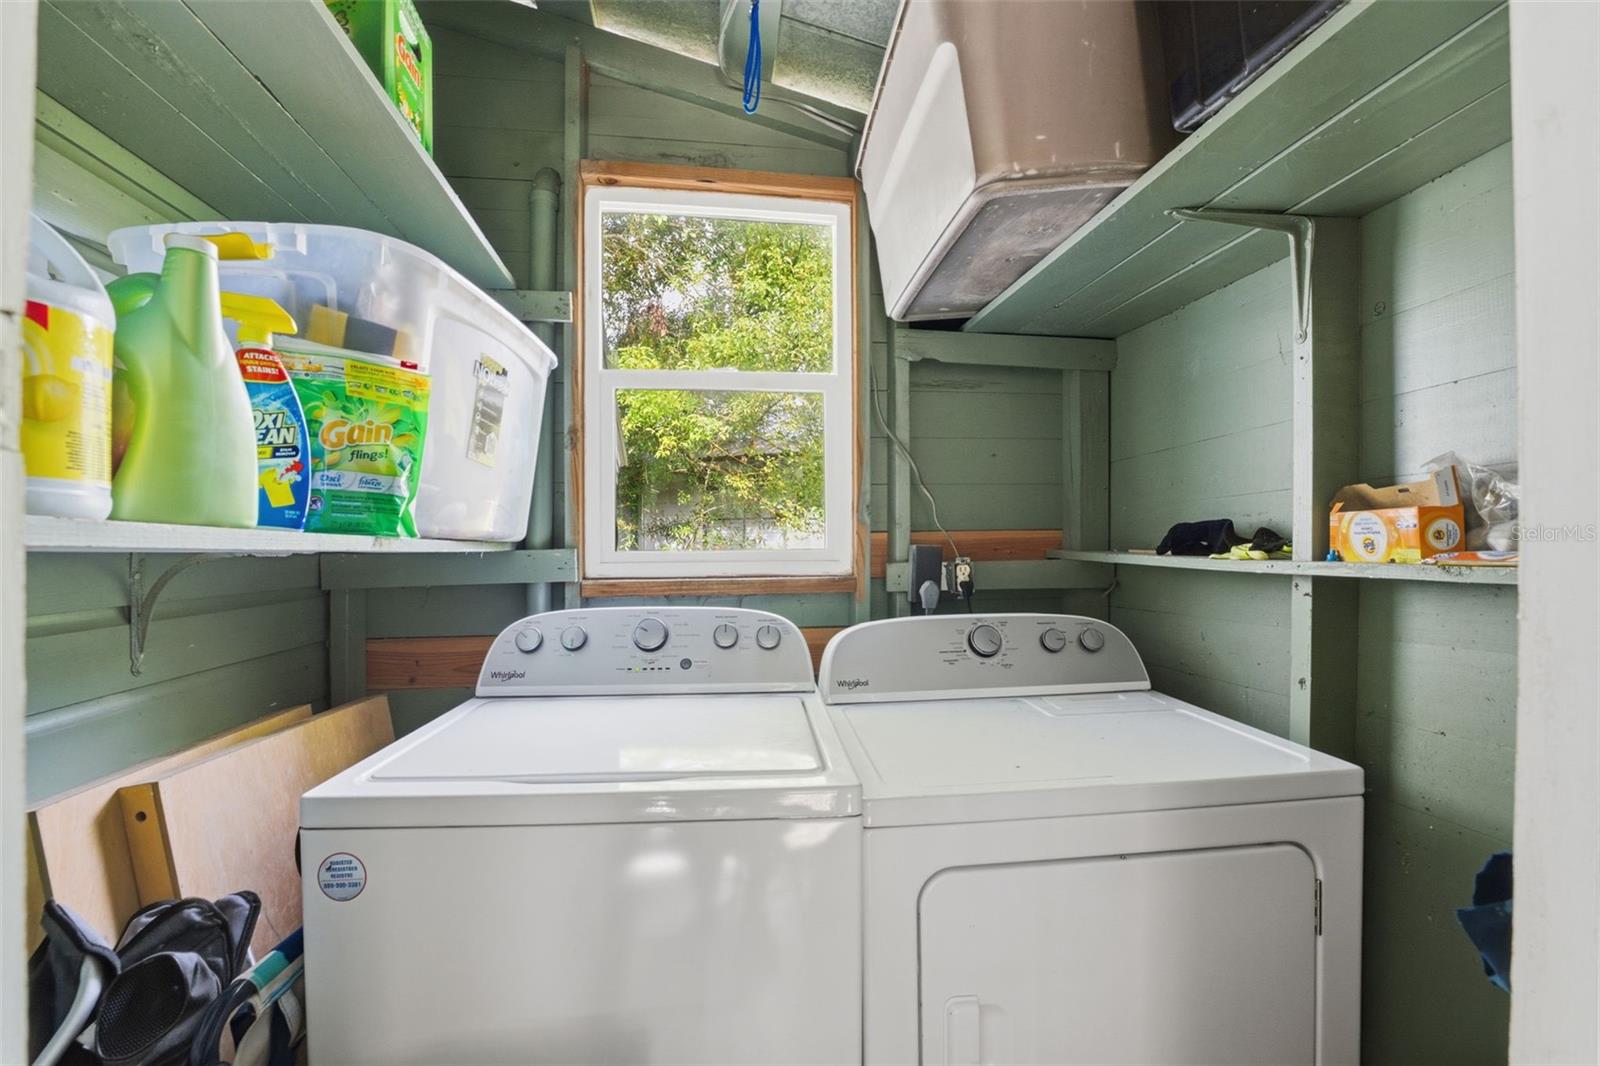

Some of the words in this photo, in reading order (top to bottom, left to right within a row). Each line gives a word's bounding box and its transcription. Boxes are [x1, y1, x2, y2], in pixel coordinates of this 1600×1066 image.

[256, 427, 296, 445] EAN
[320, 419, 392, 449] Gain
[348, 448, 389, 462] flings!
[490, 670, 526, 682] Whirlpool
[836, 678, 869, 691] Whirlpool
